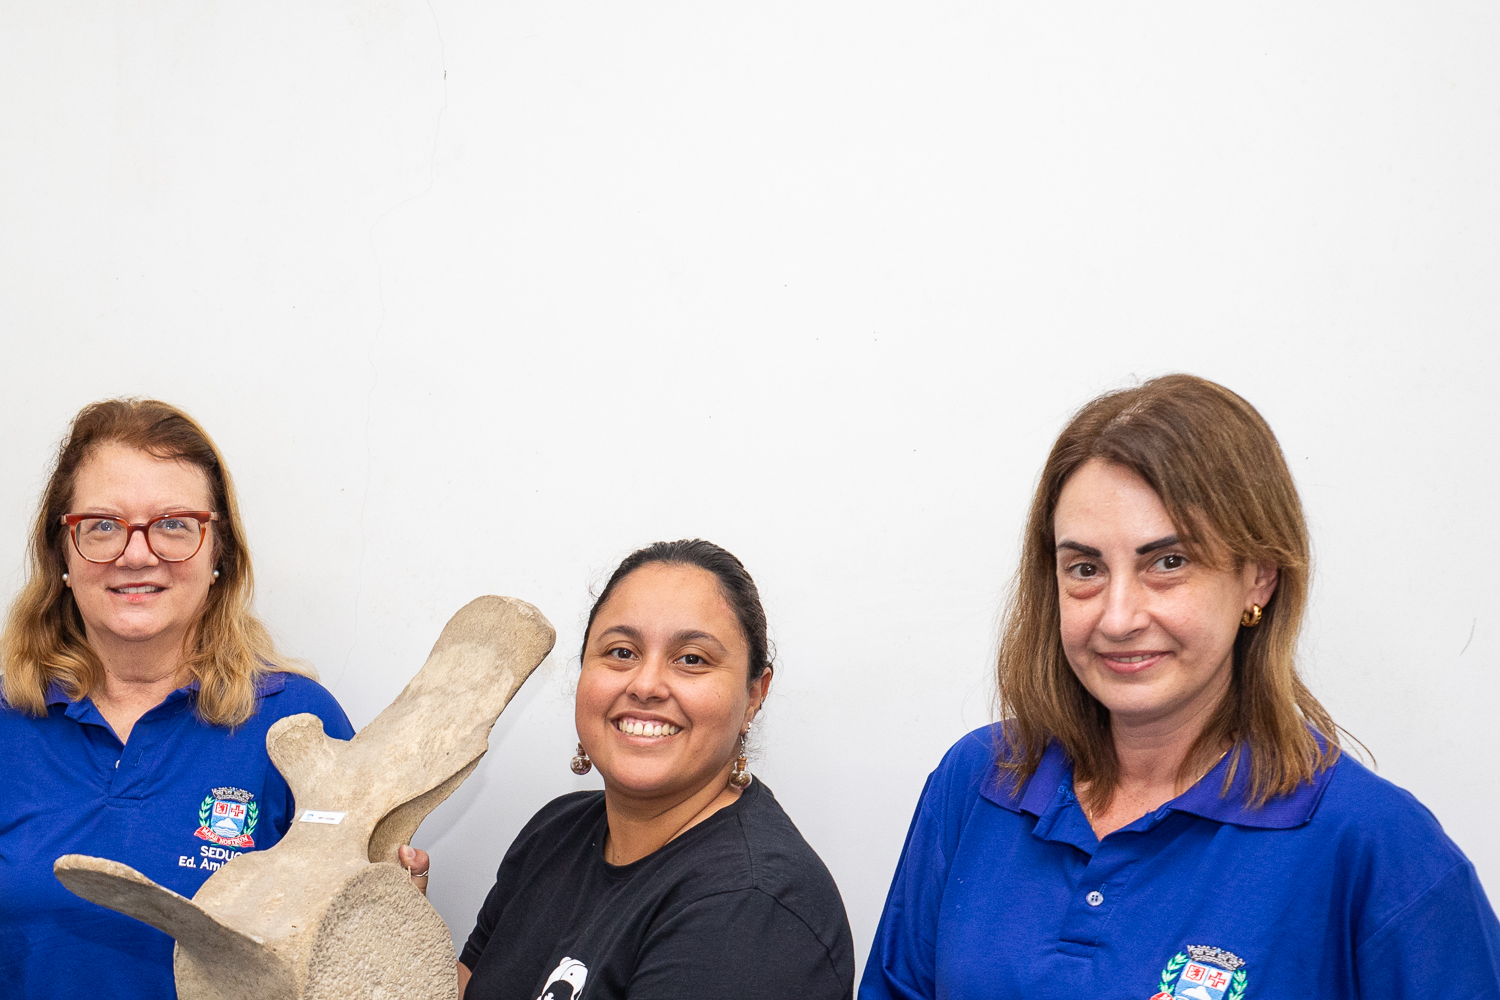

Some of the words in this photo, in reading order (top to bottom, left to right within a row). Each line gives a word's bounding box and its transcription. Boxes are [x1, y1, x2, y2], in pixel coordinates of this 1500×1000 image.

[202, 828, 218, 841] MARE
[219, 836, 248, 845] NOSTRUM
[179, 856, 196, 868] Ed.
